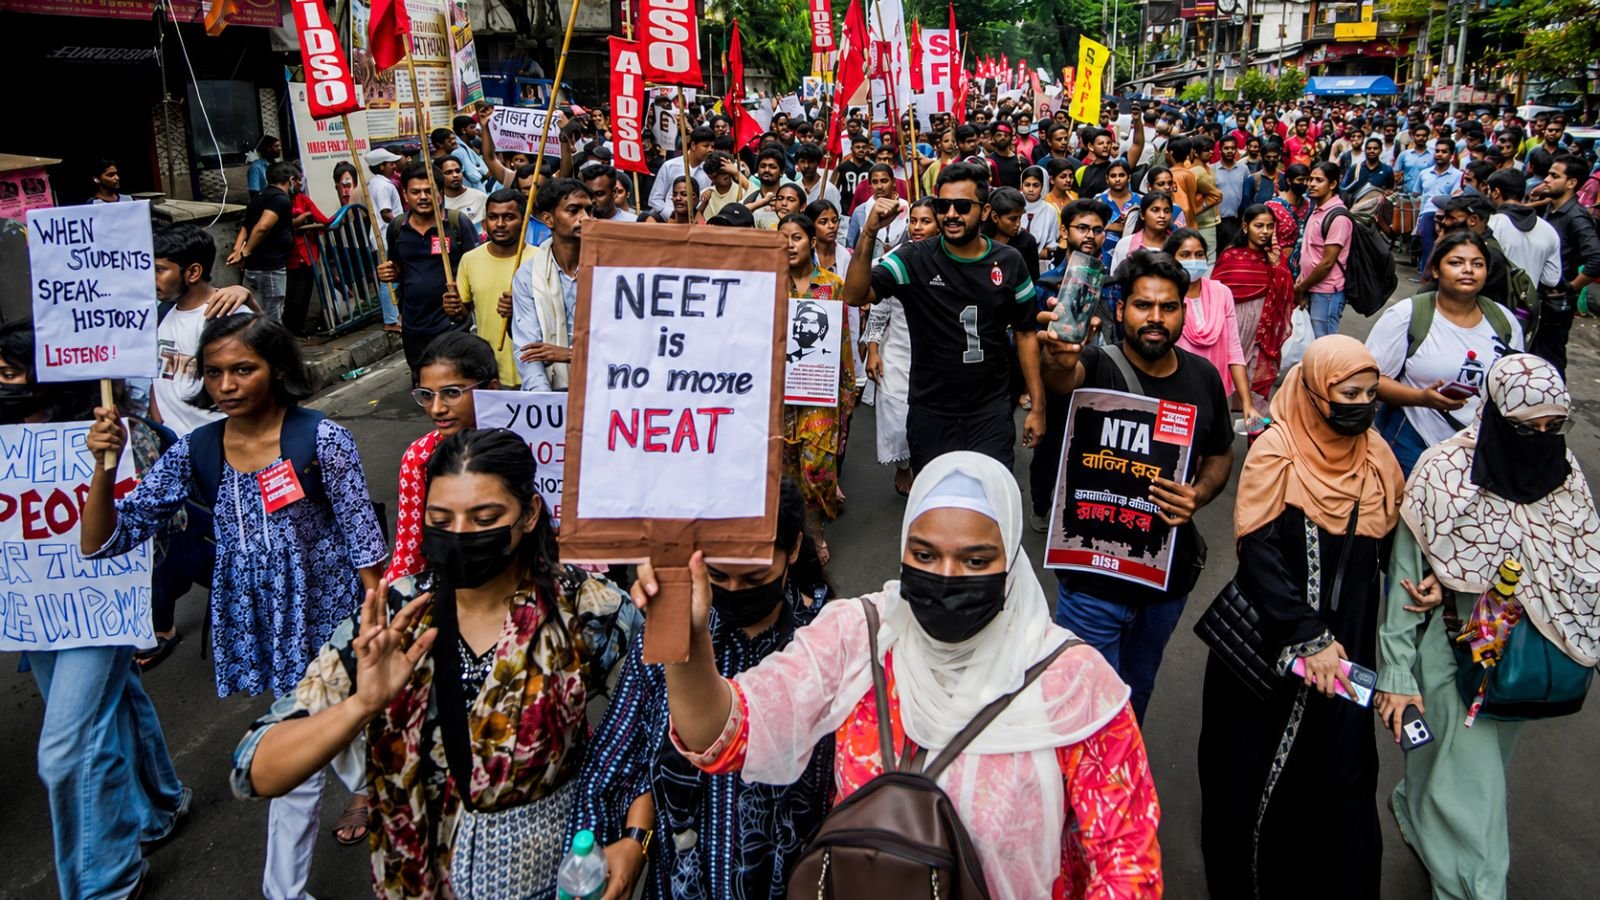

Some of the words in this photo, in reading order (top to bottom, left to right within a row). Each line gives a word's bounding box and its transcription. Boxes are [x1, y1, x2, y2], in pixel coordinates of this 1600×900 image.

[296, 0, 348, 107] IDSO
[929, 34, 950, 112] SFI
[615, 50, 642, 162] AIDSO
[33, 217, 94, 245] WHEN
[67, 247, 151, 270] STUDENTS
[614, 273, 741, 320] NEET
[72, 308, 149, 332] HISTORY
[960, 305, 984, 364] 1
[657, 326, 685, 357] is
[607, 364, 649, 390] no
[666, 370, 753, 394] more
[608, 408, 734, 454] NEAT
[1100, 417, 1150, 454] NTA
